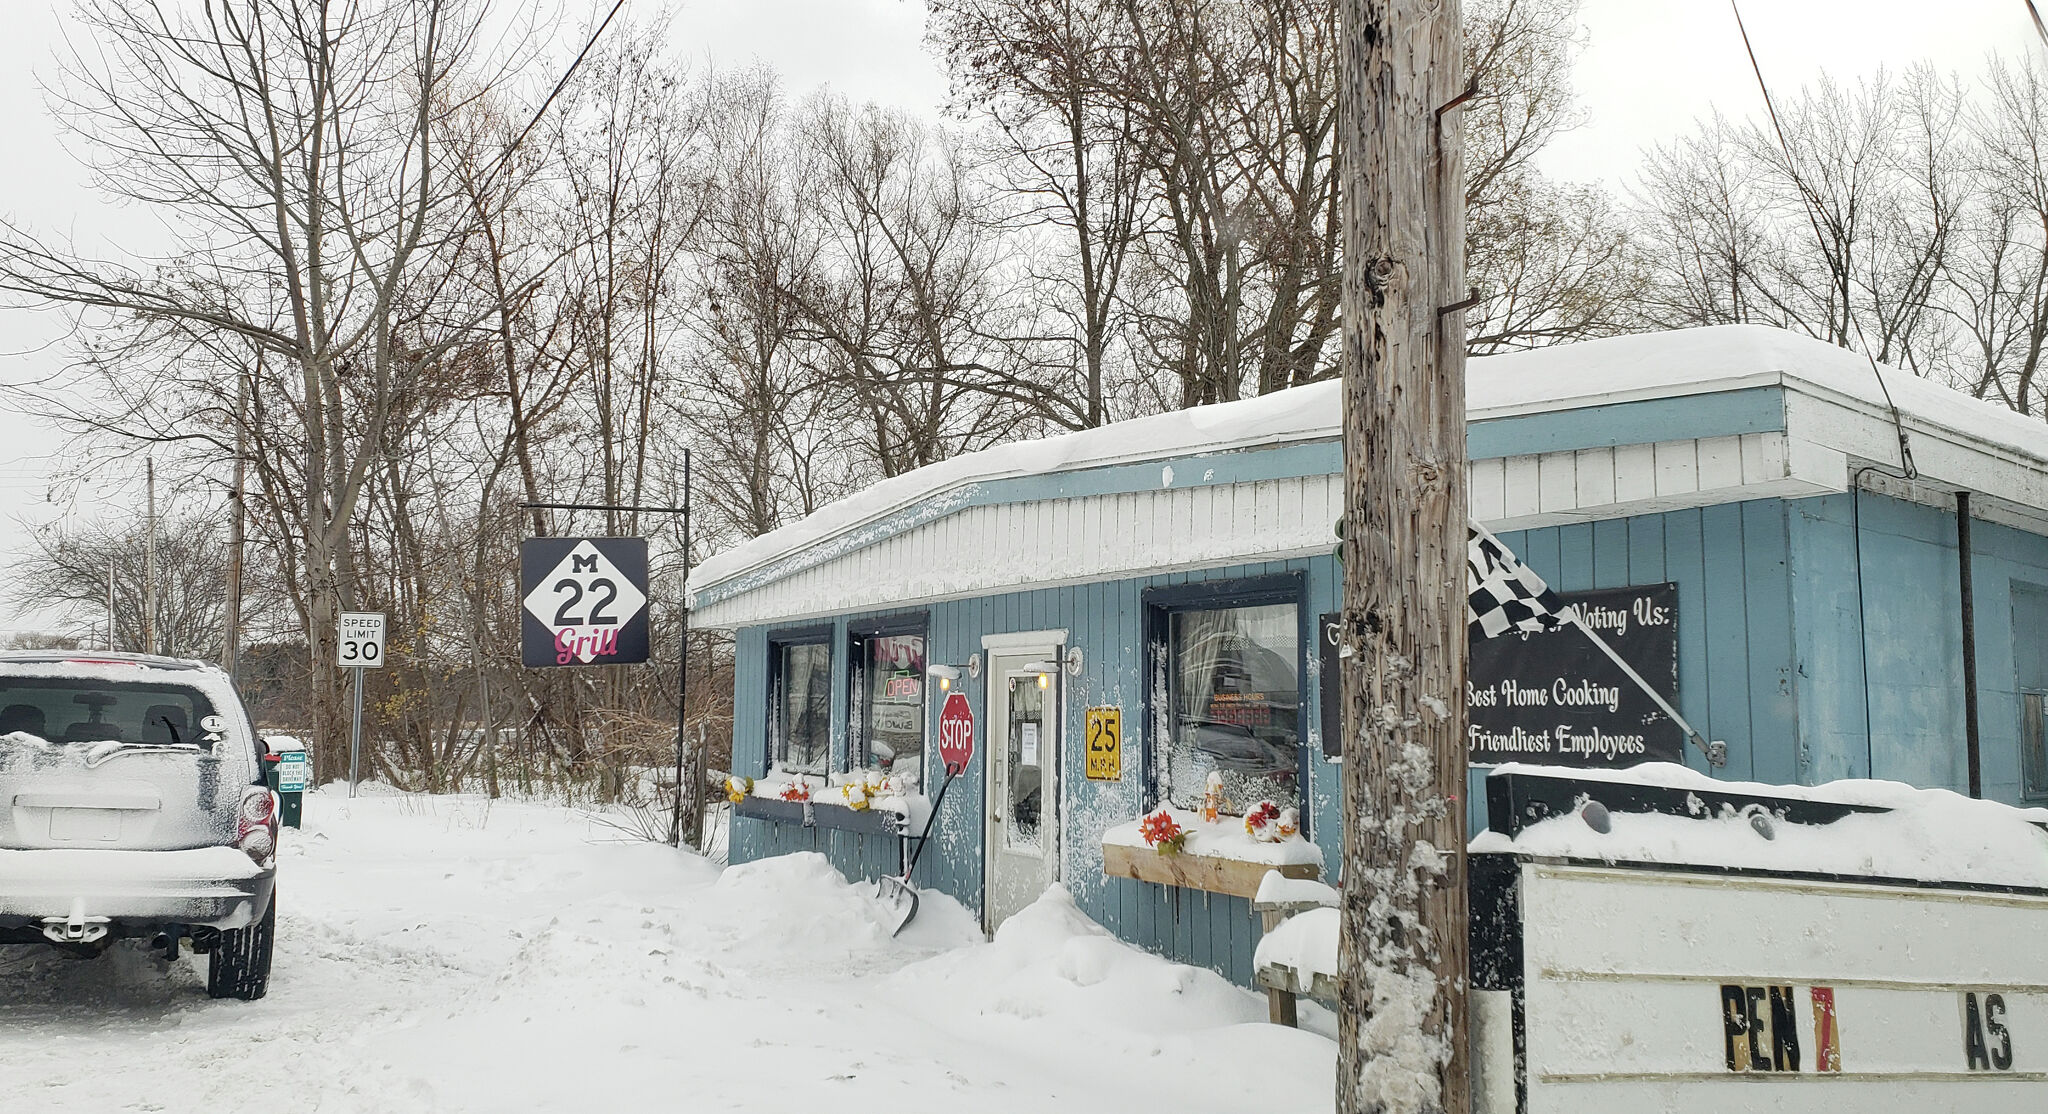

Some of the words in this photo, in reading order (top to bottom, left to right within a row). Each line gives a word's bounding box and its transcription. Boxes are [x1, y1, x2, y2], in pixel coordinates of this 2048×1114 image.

[572, 553, 598, 573] M
[553, 577, 618, 626] 22
[1571, 602, 1627, 636] Voting
[1633, 597, 1670, 626] Us:
[343, 618, 381, 628] SPEED
[346, 630, 376, 639] LIMIT
[342, 641, 379, 660] 30
[554, 627, 619, 664] Grill
[887, 678, 918, 697] OPEN
[1501, 679, 1548, 707] Home
[1552, 677, 1619, 713] Cooking
[941, 719, 971, 750] STOP
[1090, 717, 1116, 753] 25
[1468, 724, 1551, 752] Friendliest
[1555, 724, 1646, 761] Employees
[1721, 985, 1800, 1072] PEN
[1966, 992, 2013, 1071] AS
